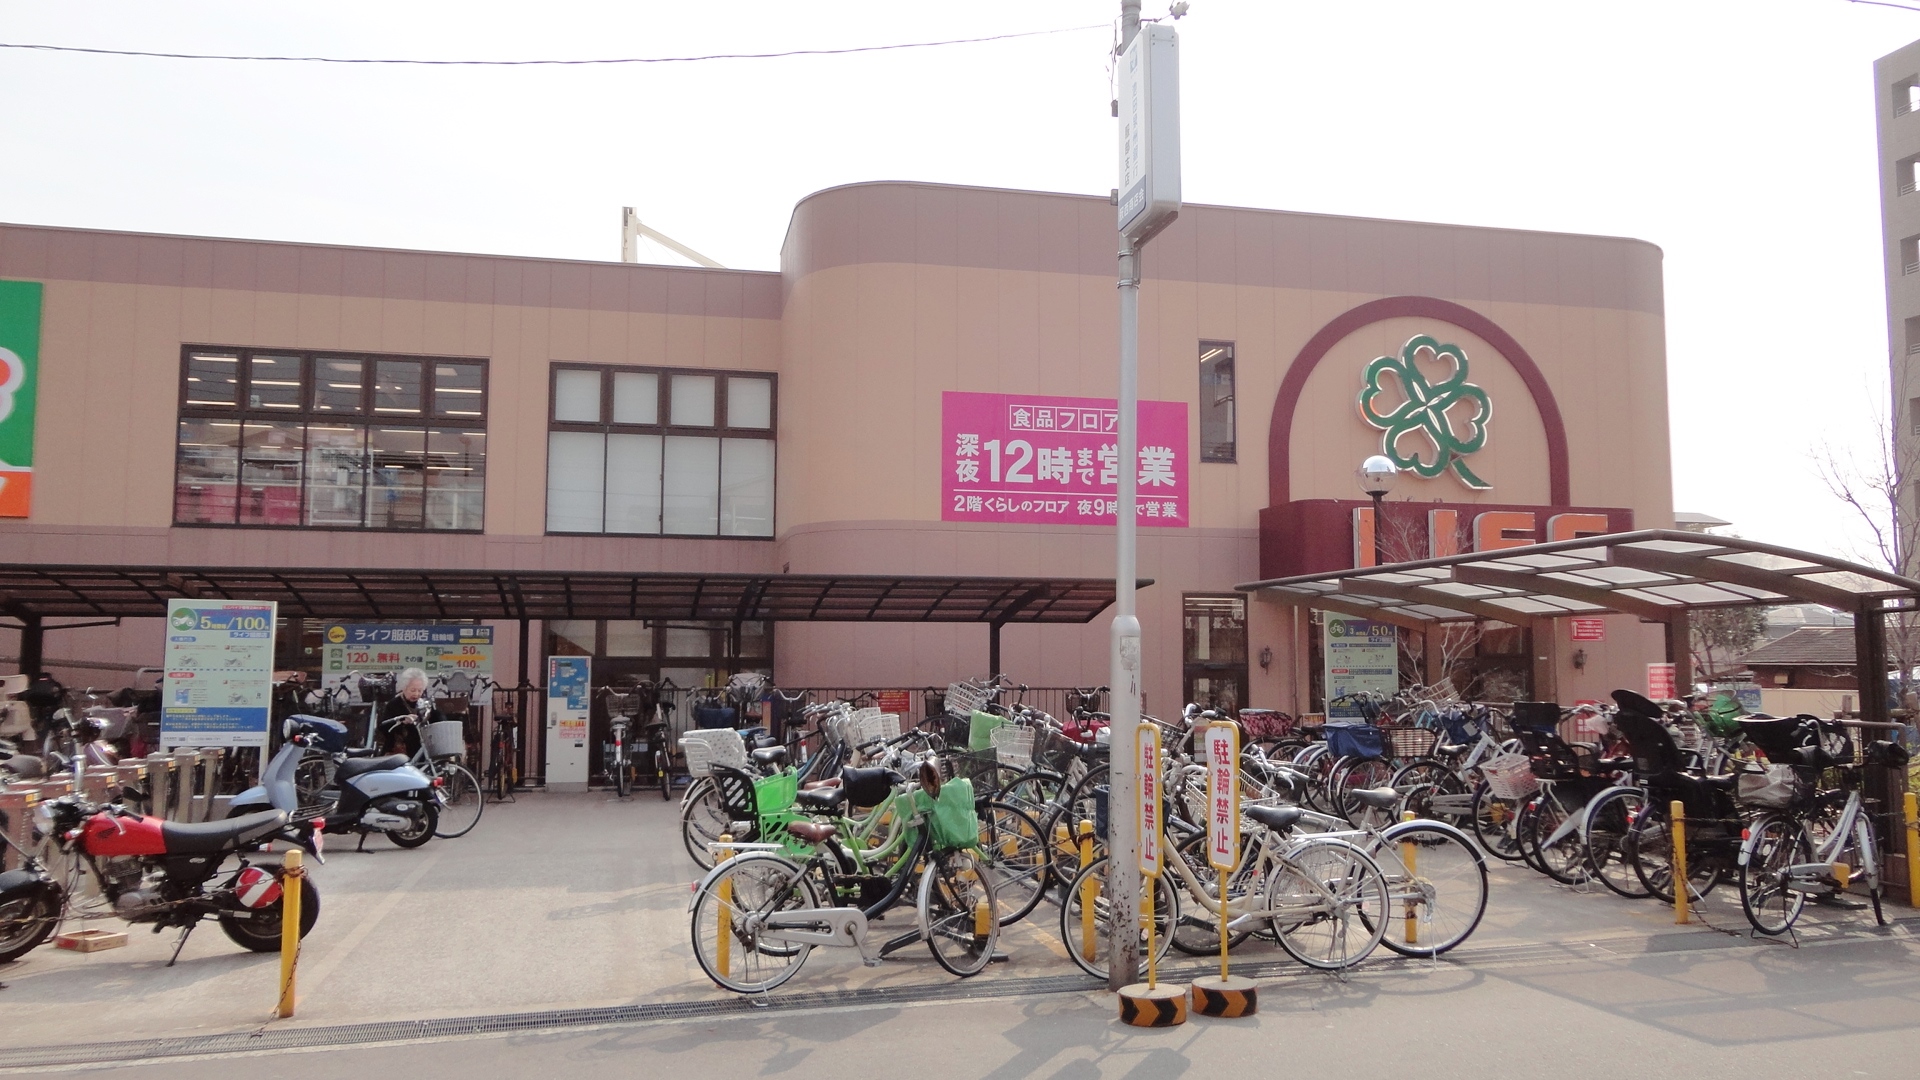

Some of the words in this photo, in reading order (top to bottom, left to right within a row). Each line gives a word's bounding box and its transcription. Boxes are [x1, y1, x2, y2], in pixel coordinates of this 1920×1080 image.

[1013, 408, 1118, 431] 食品フロア
[1077, 498, 1178, 518] 夜9時で営業
[354, 629, 429, 642] ライフ服部店
[1143, 742, 1155, 861] 駐輪禁止
[1213, 739, 1231, 855] 駐輪禁止
